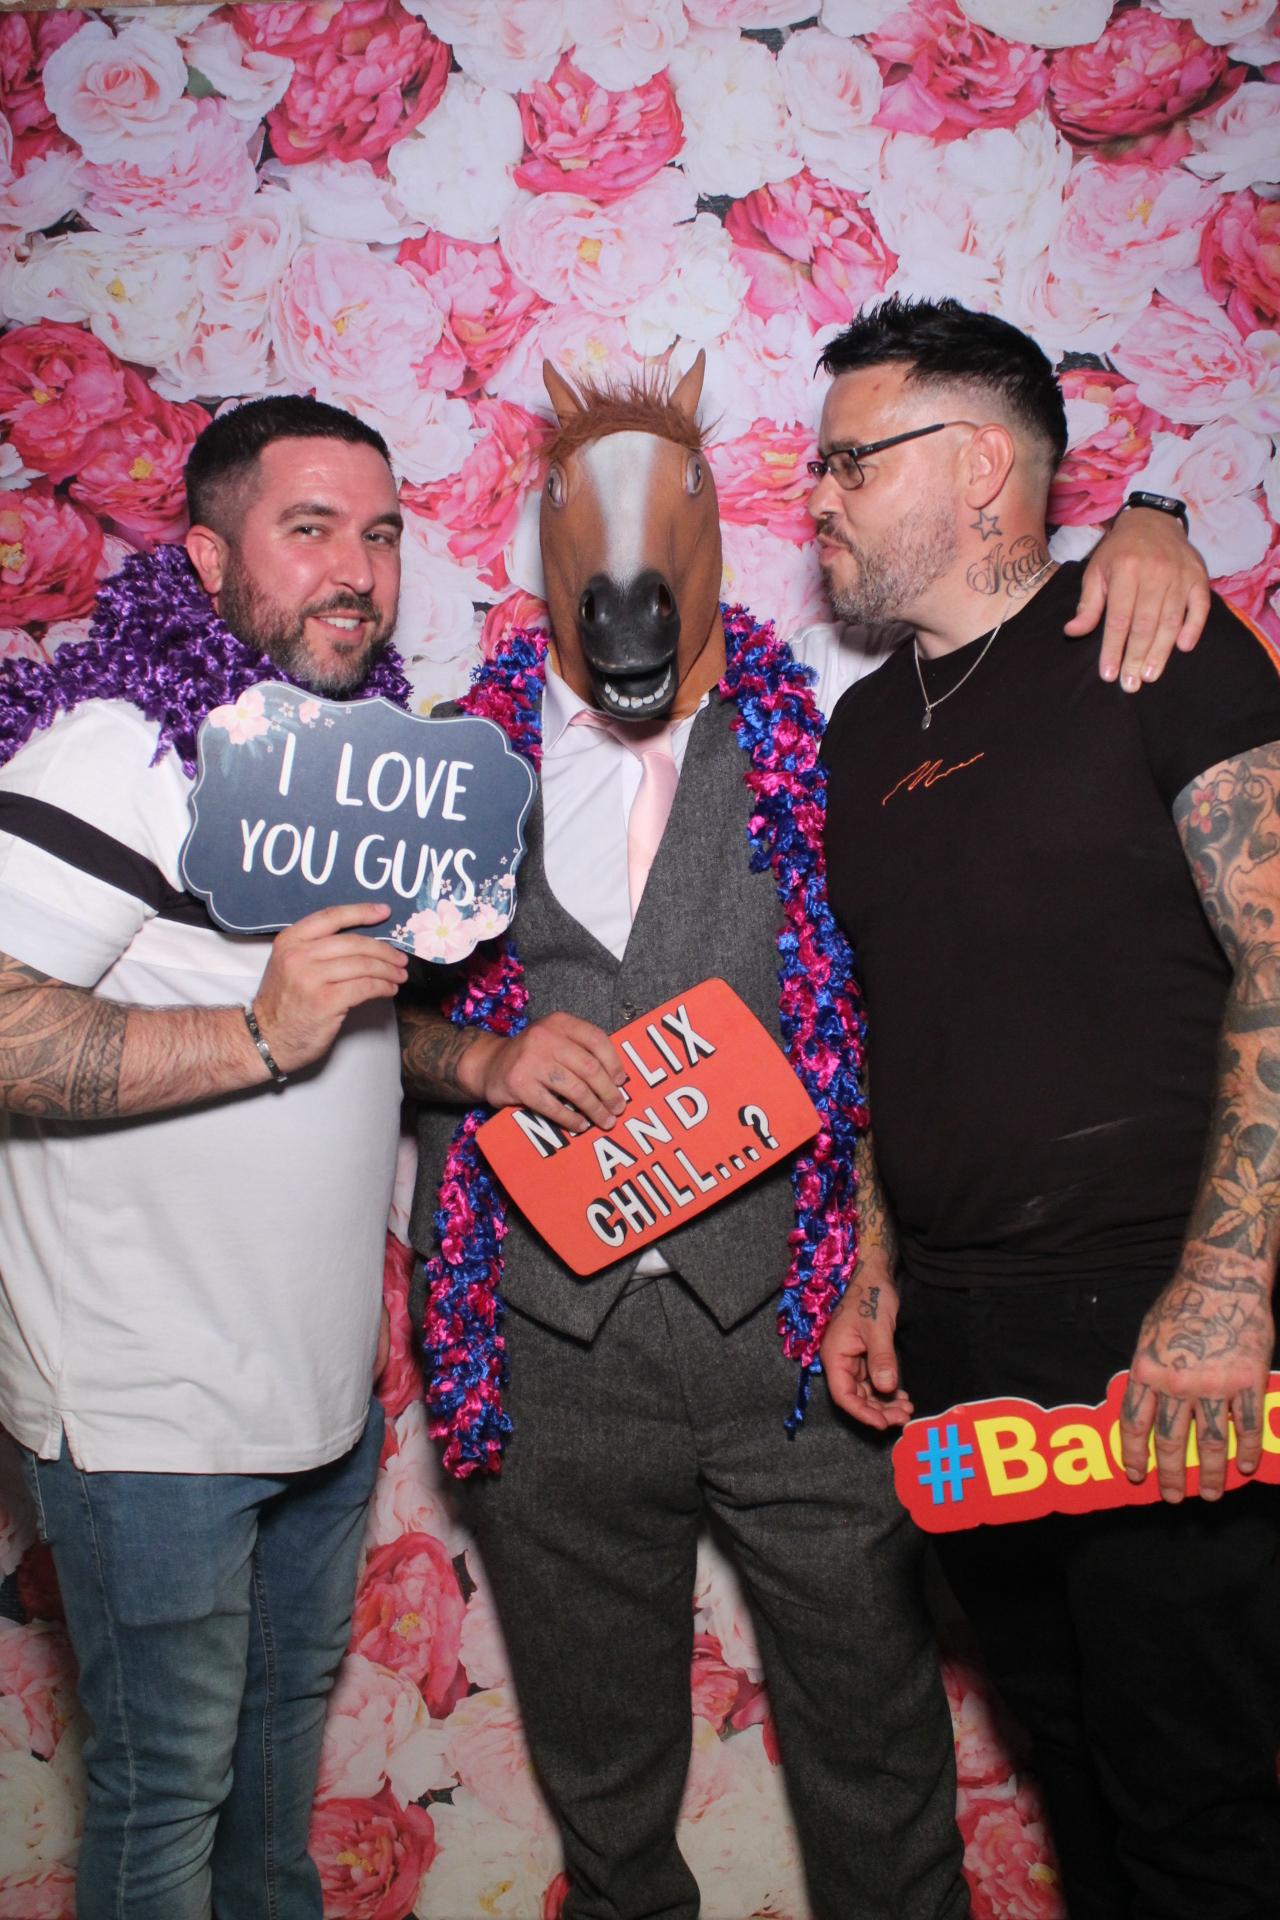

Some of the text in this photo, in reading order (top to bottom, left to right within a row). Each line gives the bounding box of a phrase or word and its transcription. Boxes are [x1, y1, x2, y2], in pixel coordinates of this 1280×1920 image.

[278, 732, 475, 822] I LOVE
[240, 818, 477, 907] YOU GUYS
[511, 1003, 717, 1159] NLIX
[592, 1085, 710, 1182] AND
